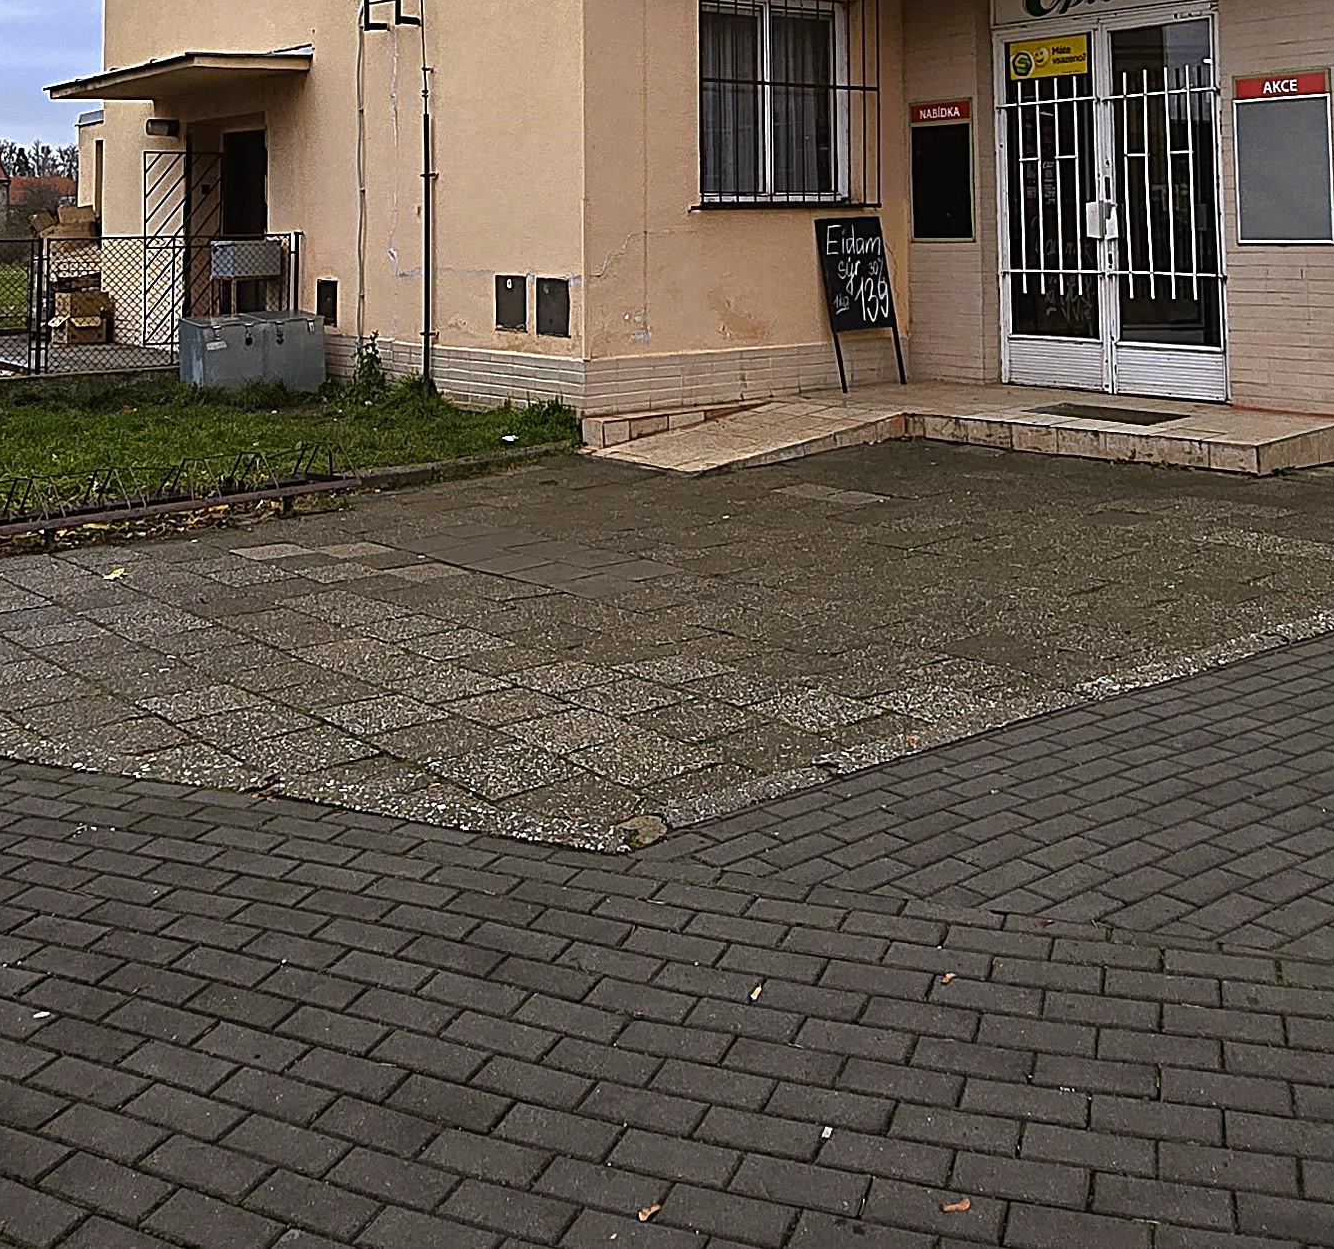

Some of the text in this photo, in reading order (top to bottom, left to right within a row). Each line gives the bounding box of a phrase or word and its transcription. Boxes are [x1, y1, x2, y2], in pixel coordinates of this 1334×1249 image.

[1263, 78, 1299, 94] AKCE
[919, 105, 961, 120] NABÍDKA
[826, 224, 881, 255] Eidam
[855, 277, 889, 322] 139
